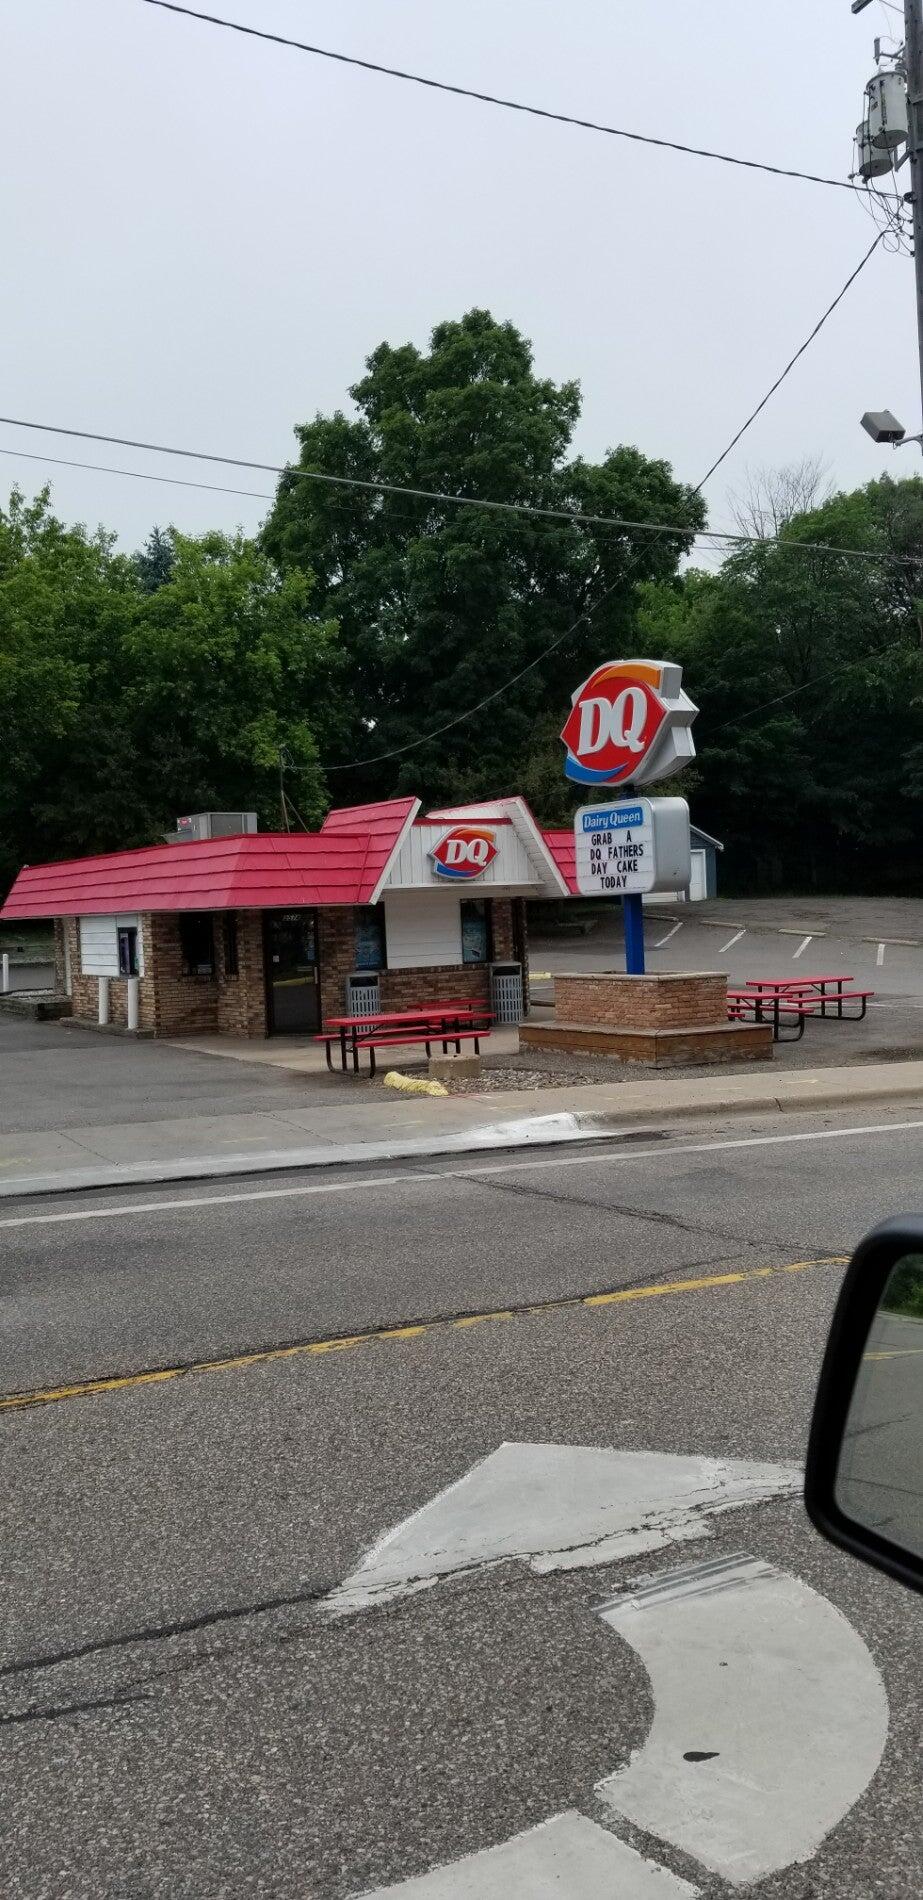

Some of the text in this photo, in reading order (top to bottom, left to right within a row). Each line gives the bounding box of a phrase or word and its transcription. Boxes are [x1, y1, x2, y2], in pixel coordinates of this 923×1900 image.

[577, 687, 647, 755] DQ
[584, 812, 640, 828] Dairy Queen
[591, 830, 632, 845] GRAB A
[445, 838, 489, 866] DQ
[590, 844, 644, 860] DQ FATHERS
[591, 860, 638, 875] DAY CAKE
[600, 875, 627, 889] TODAY
